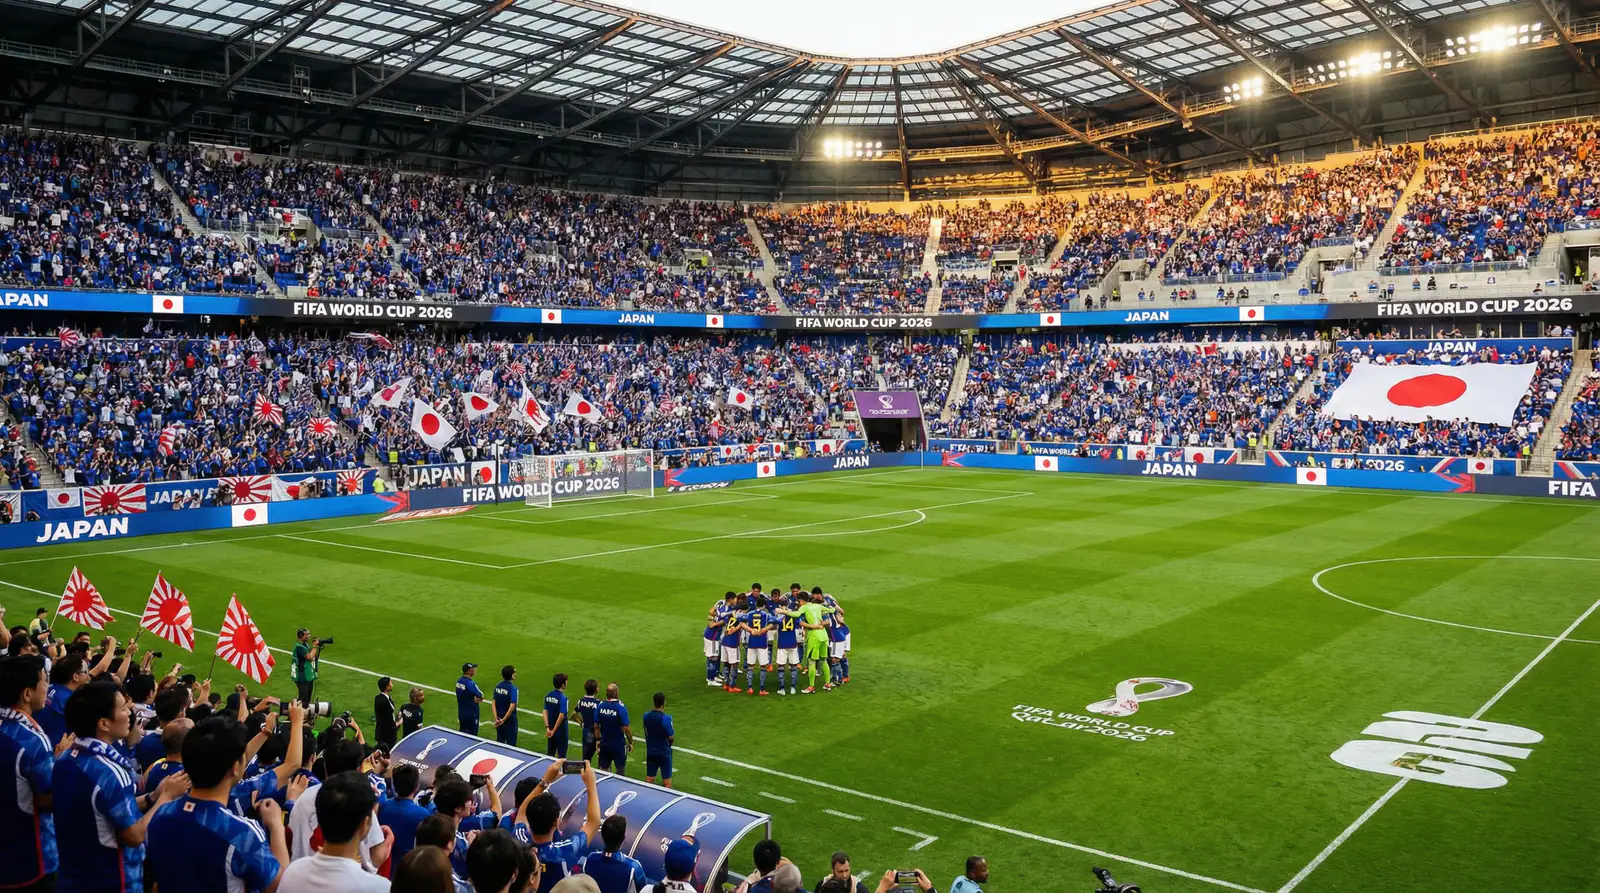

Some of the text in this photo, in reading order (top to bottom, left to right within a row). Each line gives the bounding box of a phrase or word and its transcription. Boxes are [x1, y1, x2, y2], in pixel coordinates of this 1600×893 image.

[293, 302, 453, 319] FIFA WORLD CUP 2026
[1377, 297, 1573, 316] FIFA WORLD CUP 2026
[618, 313, 655, 324] JAPAN
[795, 317, 933, 328] FIFA WORLD CUP 2026
[1124, 311, 1169, 322] JAPAN
[1423, 341, 1477, 353] JAPAN
[833, 455, 869, 469] JAPAN
[1142, 462, 1197, 477] JAPAN
[409, 465, 465, 487] JAPAN
[462, 477, 620, 503] FIFA WORLD CUP 2026
[1548, 480, 1597, 497] FIFA
[36, 517, 129, 543] JAPAN
[781, 617, 794, 632] 14
[1011, 703, 1176, 737] FIFA WORLD CUP
